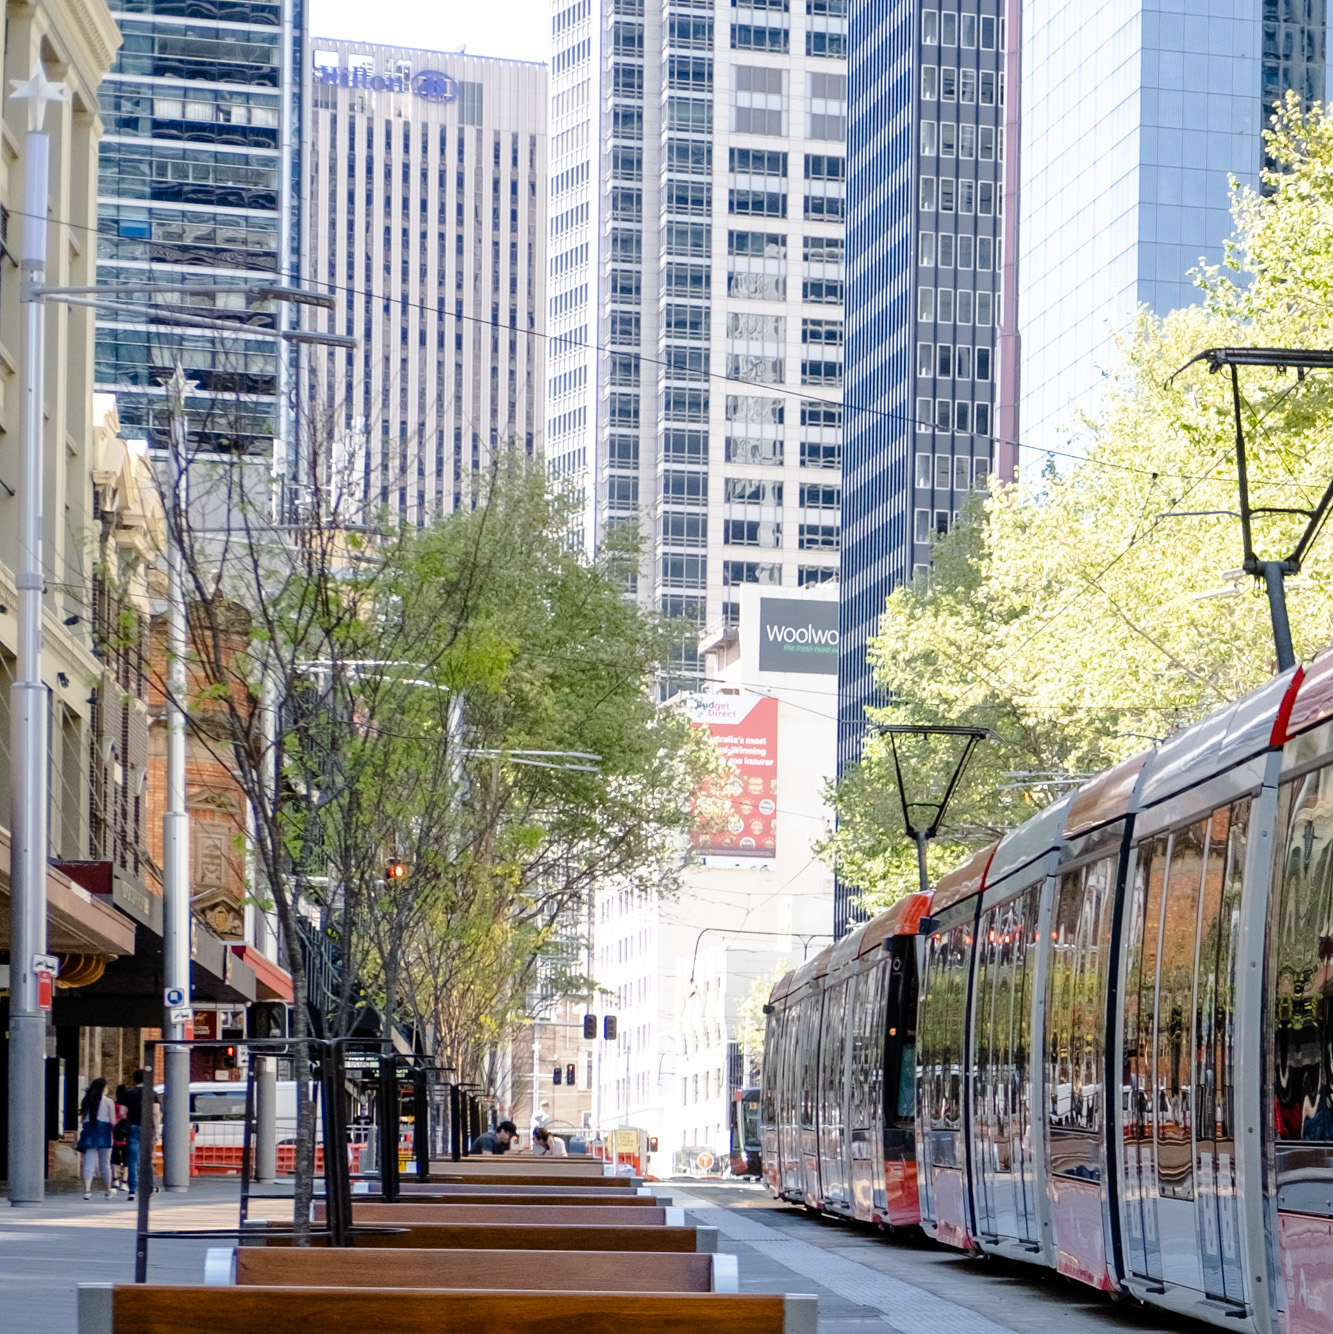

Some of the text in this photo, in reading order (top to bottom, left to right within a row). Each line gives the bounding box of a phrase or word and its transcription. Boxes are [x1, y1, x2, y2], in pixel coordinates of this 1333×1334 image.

[318, 65, 403, 93] Hilton
[708, 709, 736, 718] Direct
[745, 736, 767, 745] most
[744, 756, 774, 767] Insurer
